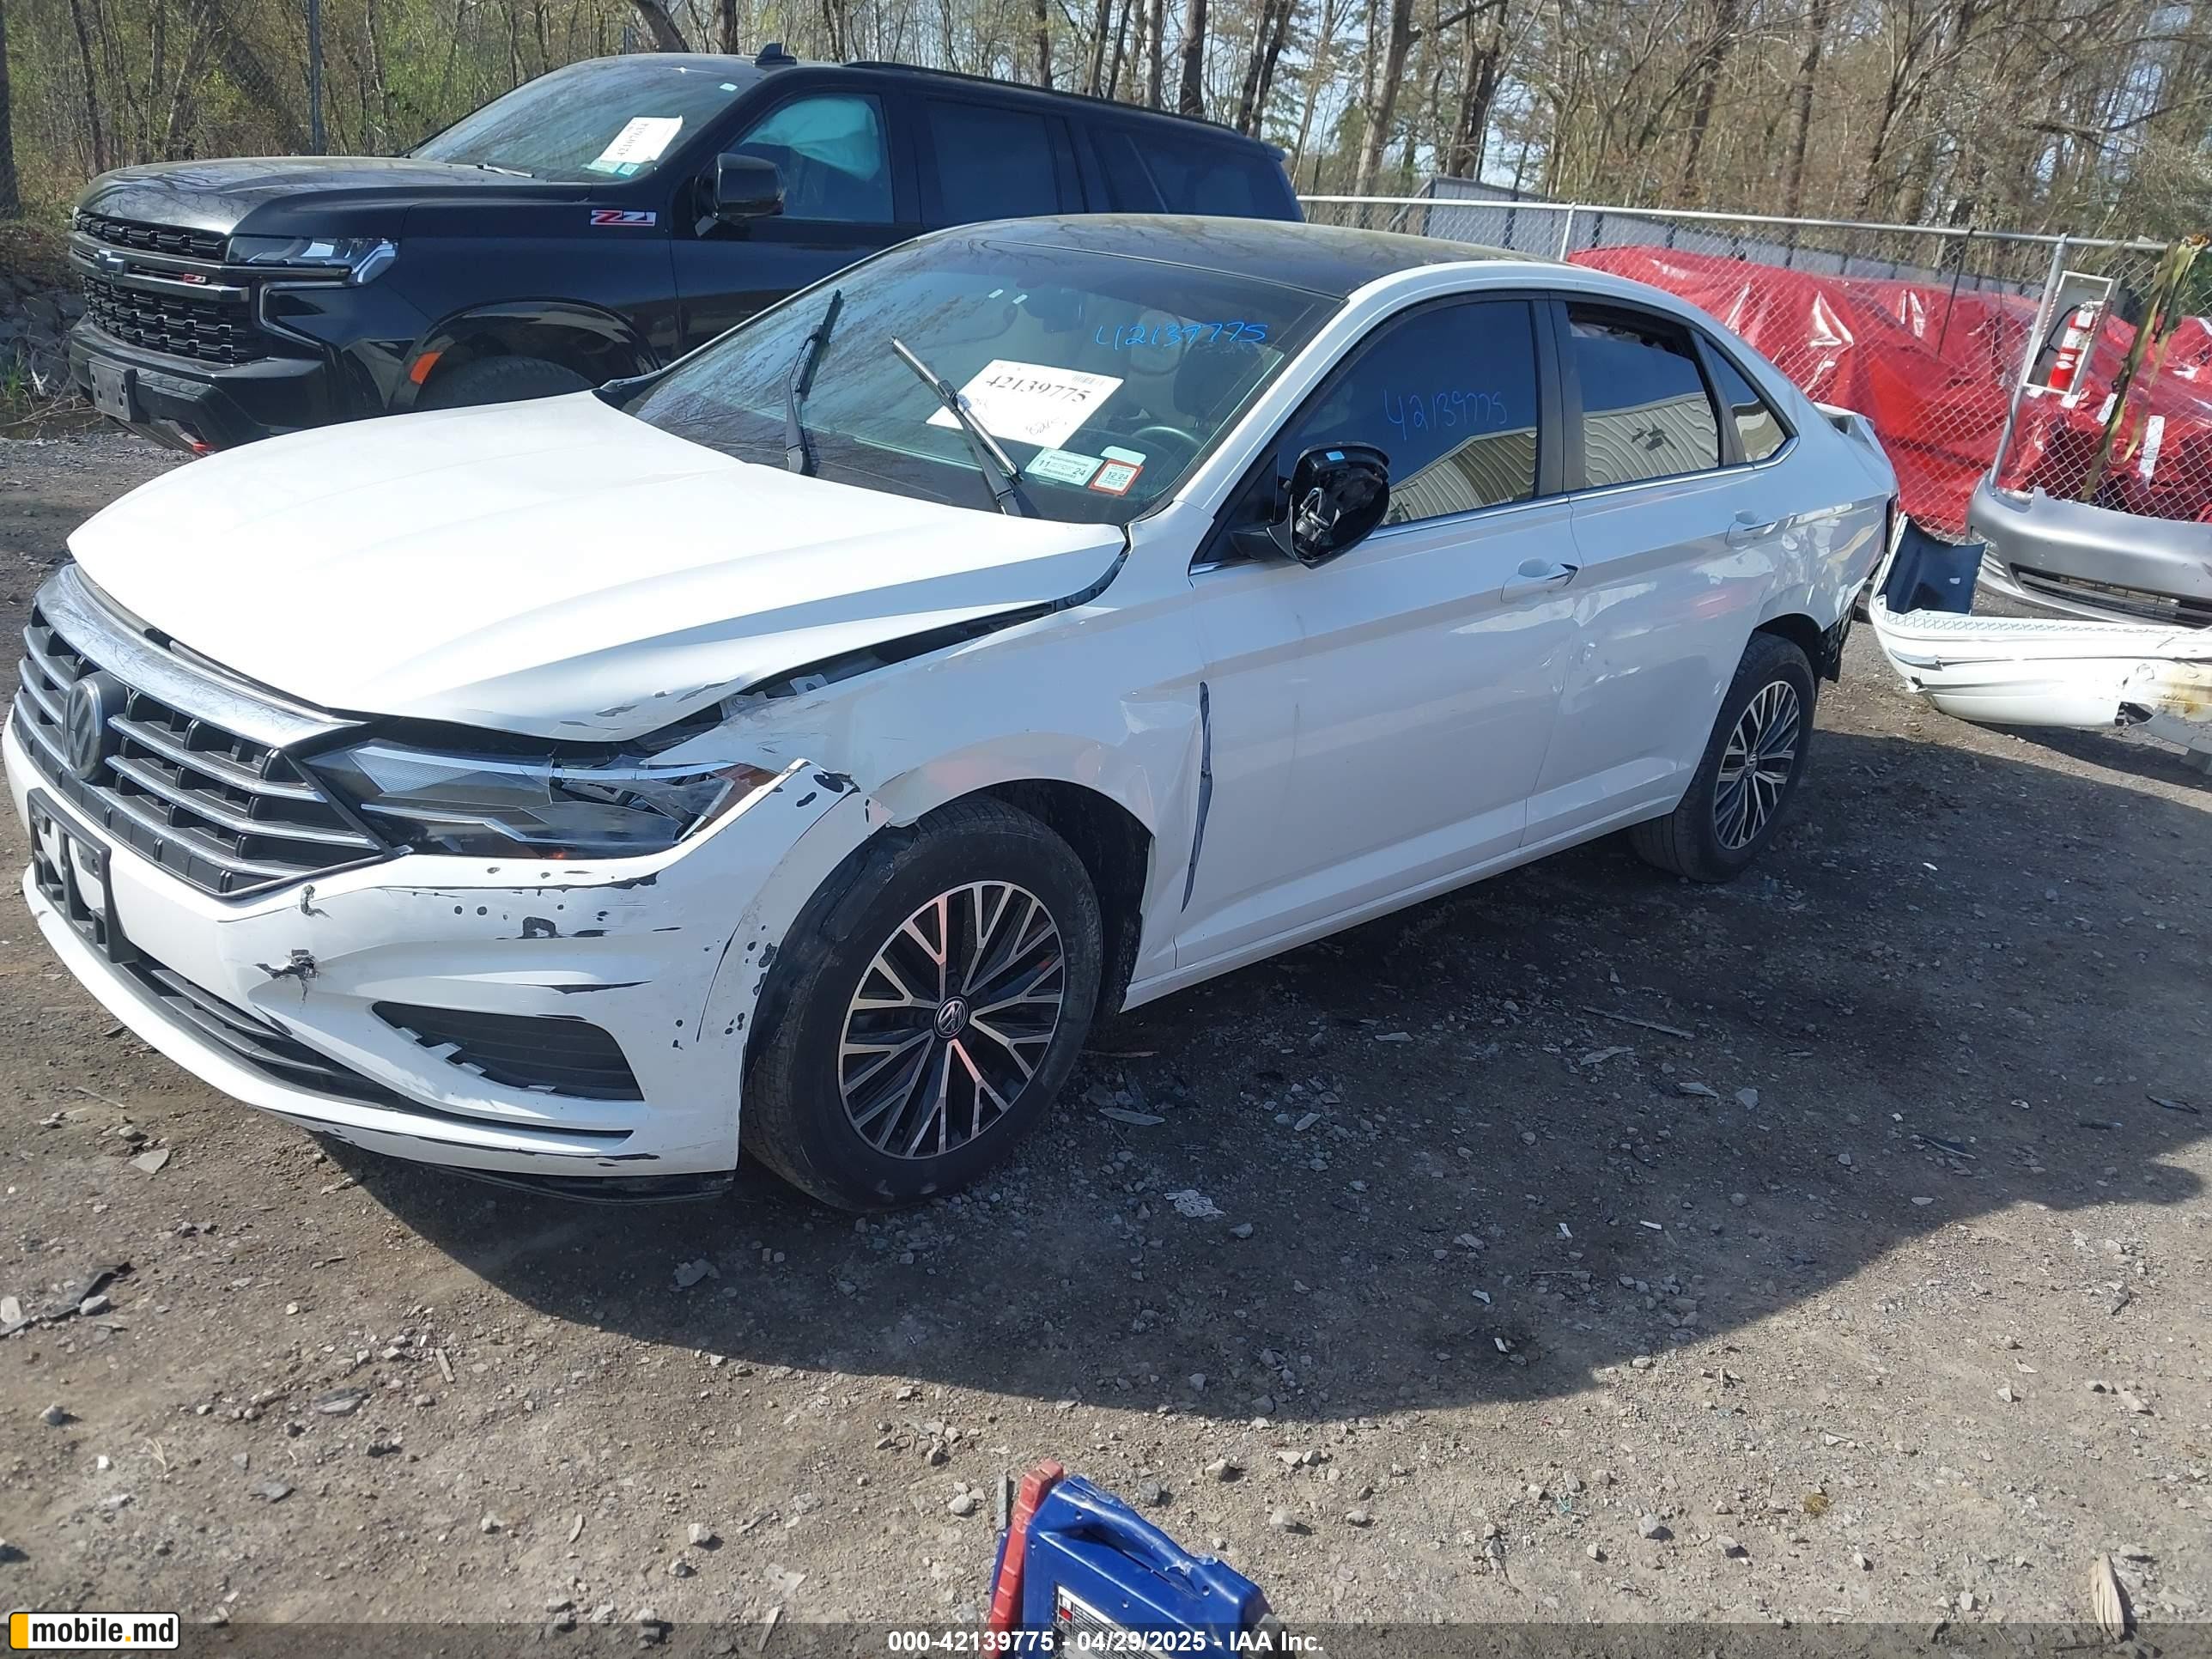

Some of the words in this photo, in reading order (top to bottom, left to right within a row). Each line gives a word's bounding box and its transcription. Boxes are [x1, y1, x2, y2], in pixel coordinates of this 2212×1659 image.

[590, 210, 657, 227] Z71
[1094, 321, 1268, 350] 42139775
[986, 374, 1091, 402] 42139775
[1383, 390, 1508, 441] 42139775
